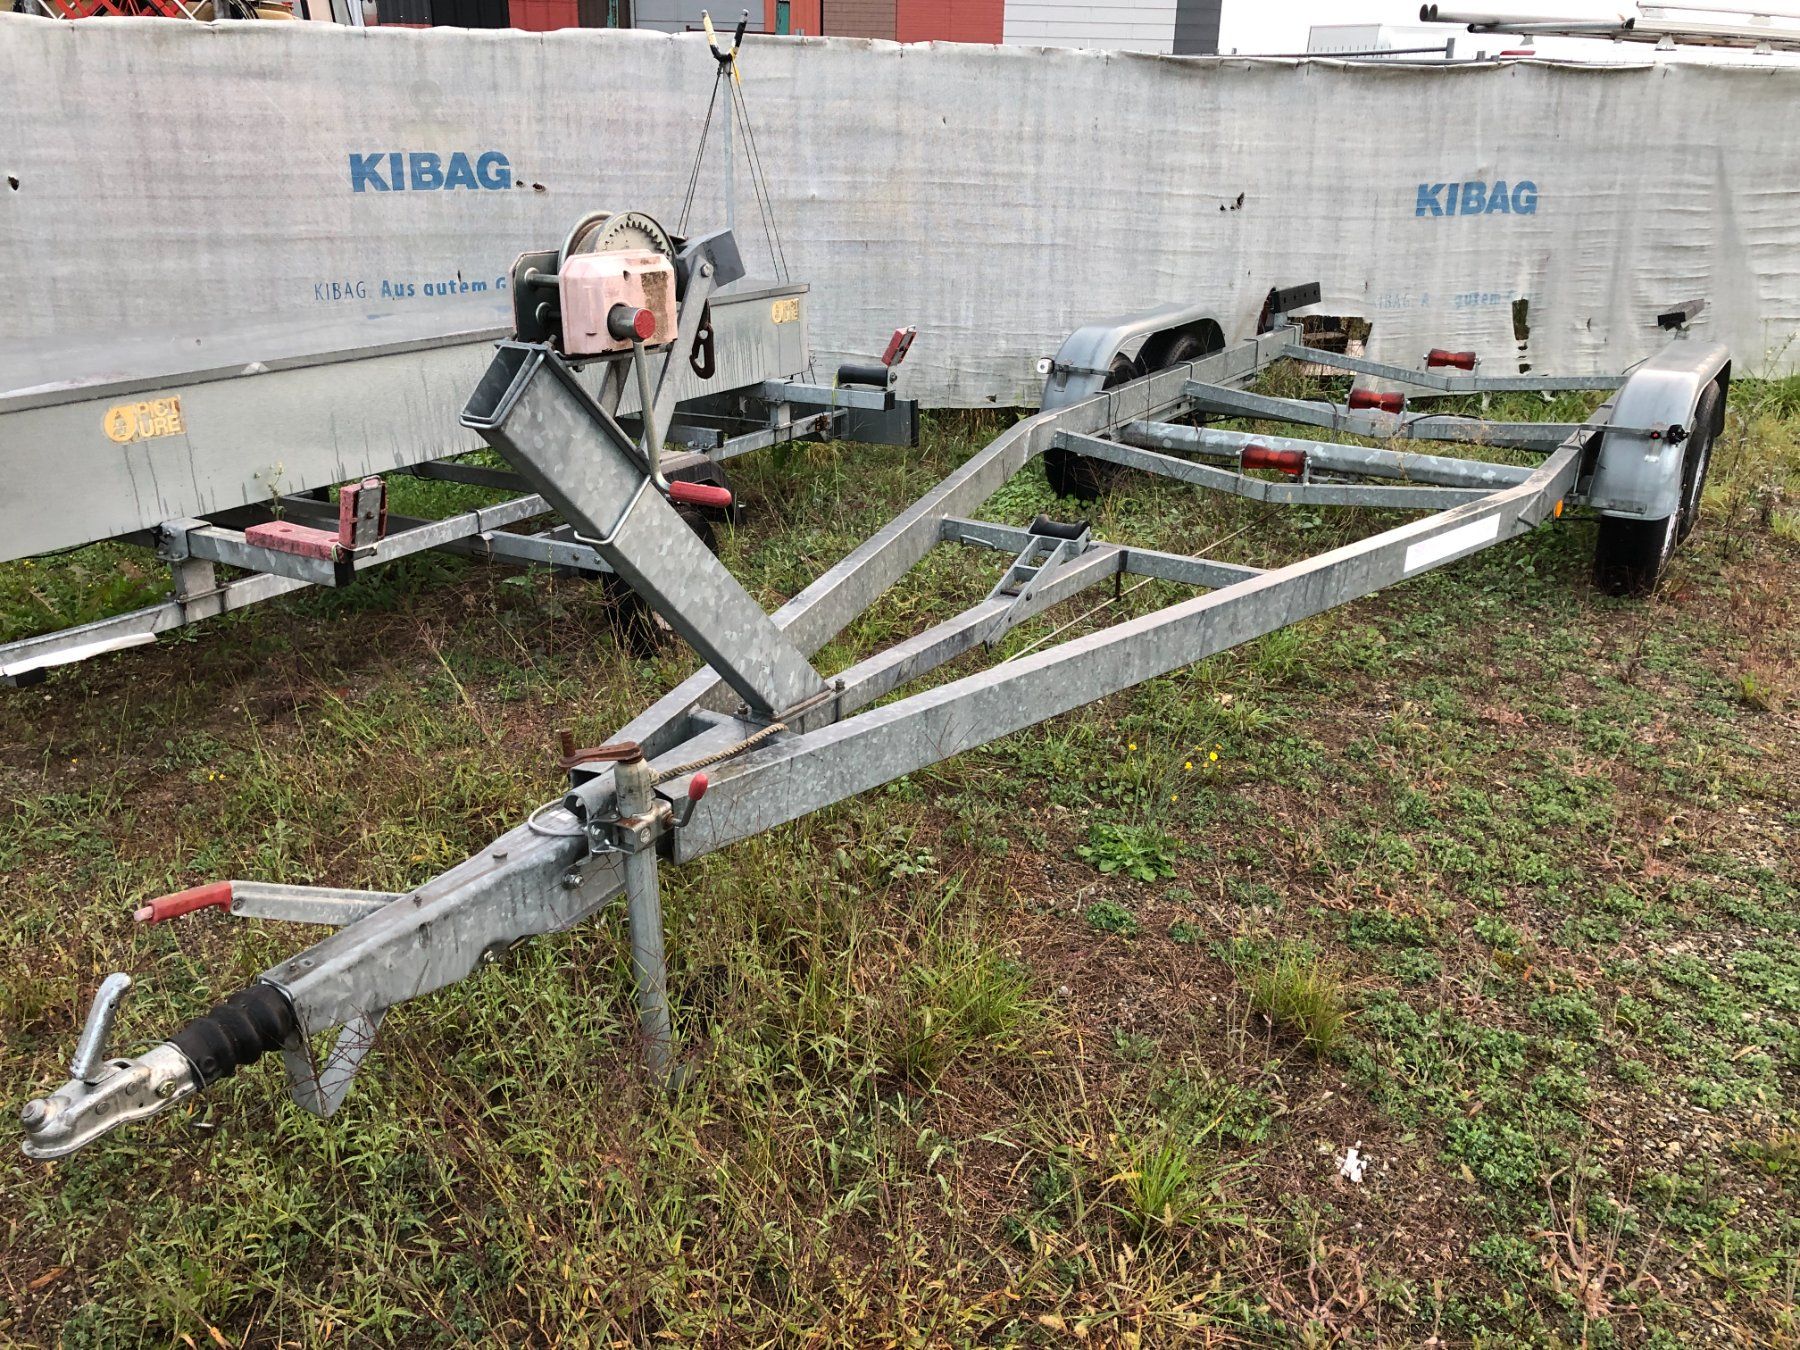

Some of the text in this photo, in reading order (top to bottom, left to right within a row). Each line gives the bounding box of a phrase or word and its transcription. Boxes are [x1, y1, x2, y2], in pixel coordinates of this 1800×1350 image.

[349, 151, 512, 192] KIBAG
[1415, 181, 1538, 217] KIBAG
[314, 281, 367, 300] KIBAG
[381, 280, 416, 298] Aus
[139, 416, 181, 438] URE
